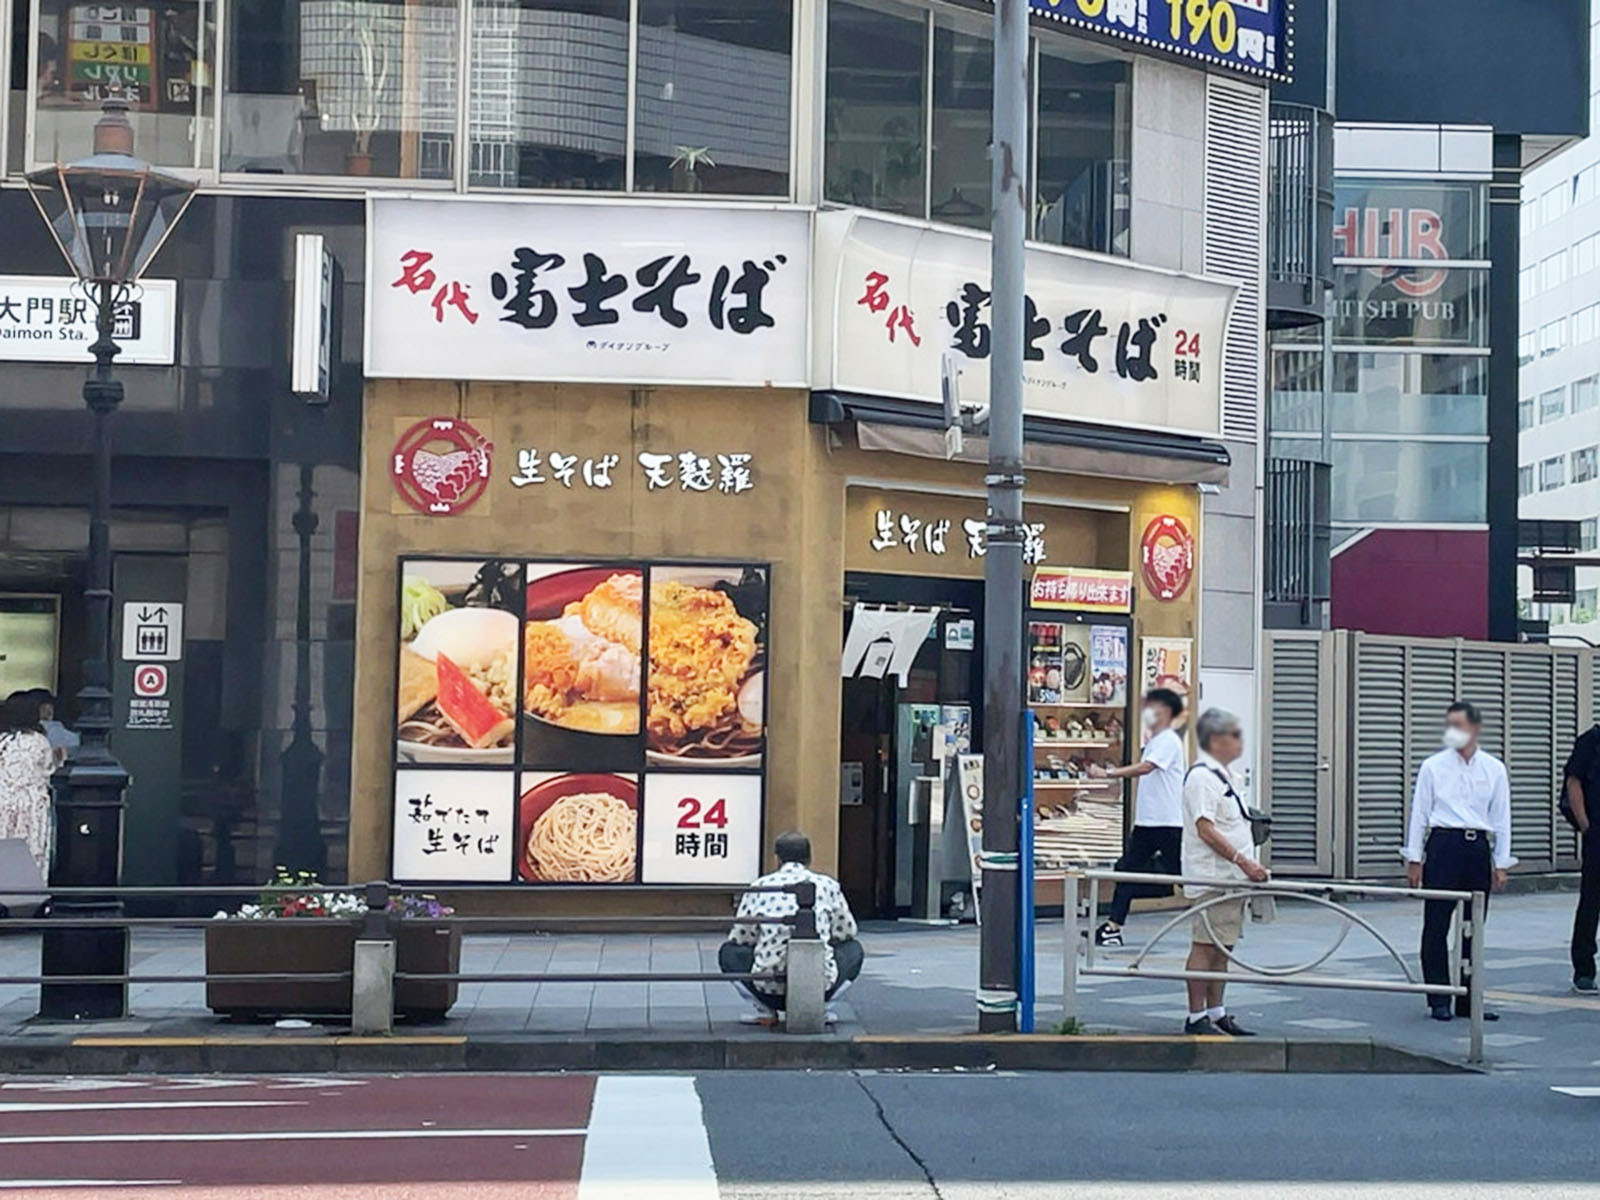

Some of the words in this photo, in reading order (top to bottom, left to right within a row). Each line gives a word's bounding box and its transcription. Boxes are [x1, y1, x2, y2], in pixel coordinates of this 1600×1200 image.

[391, 250, 479, 324] 名代
[0, 296, 87, 325] 大門駅
[858, 271, 921, 347] 名代
[1406, 301, 1455, 320] PUB
[0, 326, 53, 340] aimon
[58, 327, 89, 341] Sta.
[1175, 330, 1201, 357] 24
[1174, 359, 1201, 384] 時間
[510, 449, 620, 488] 生そば
[871, 509, 951, 555] 生そば
[963, 518, 1047, 565] 天羅
[146, 674, 155, 685] A
[676, 797, 729, 830] 24
[421, 827, 500, 856] 生そば
[675, 832, 729, 860] 時間
